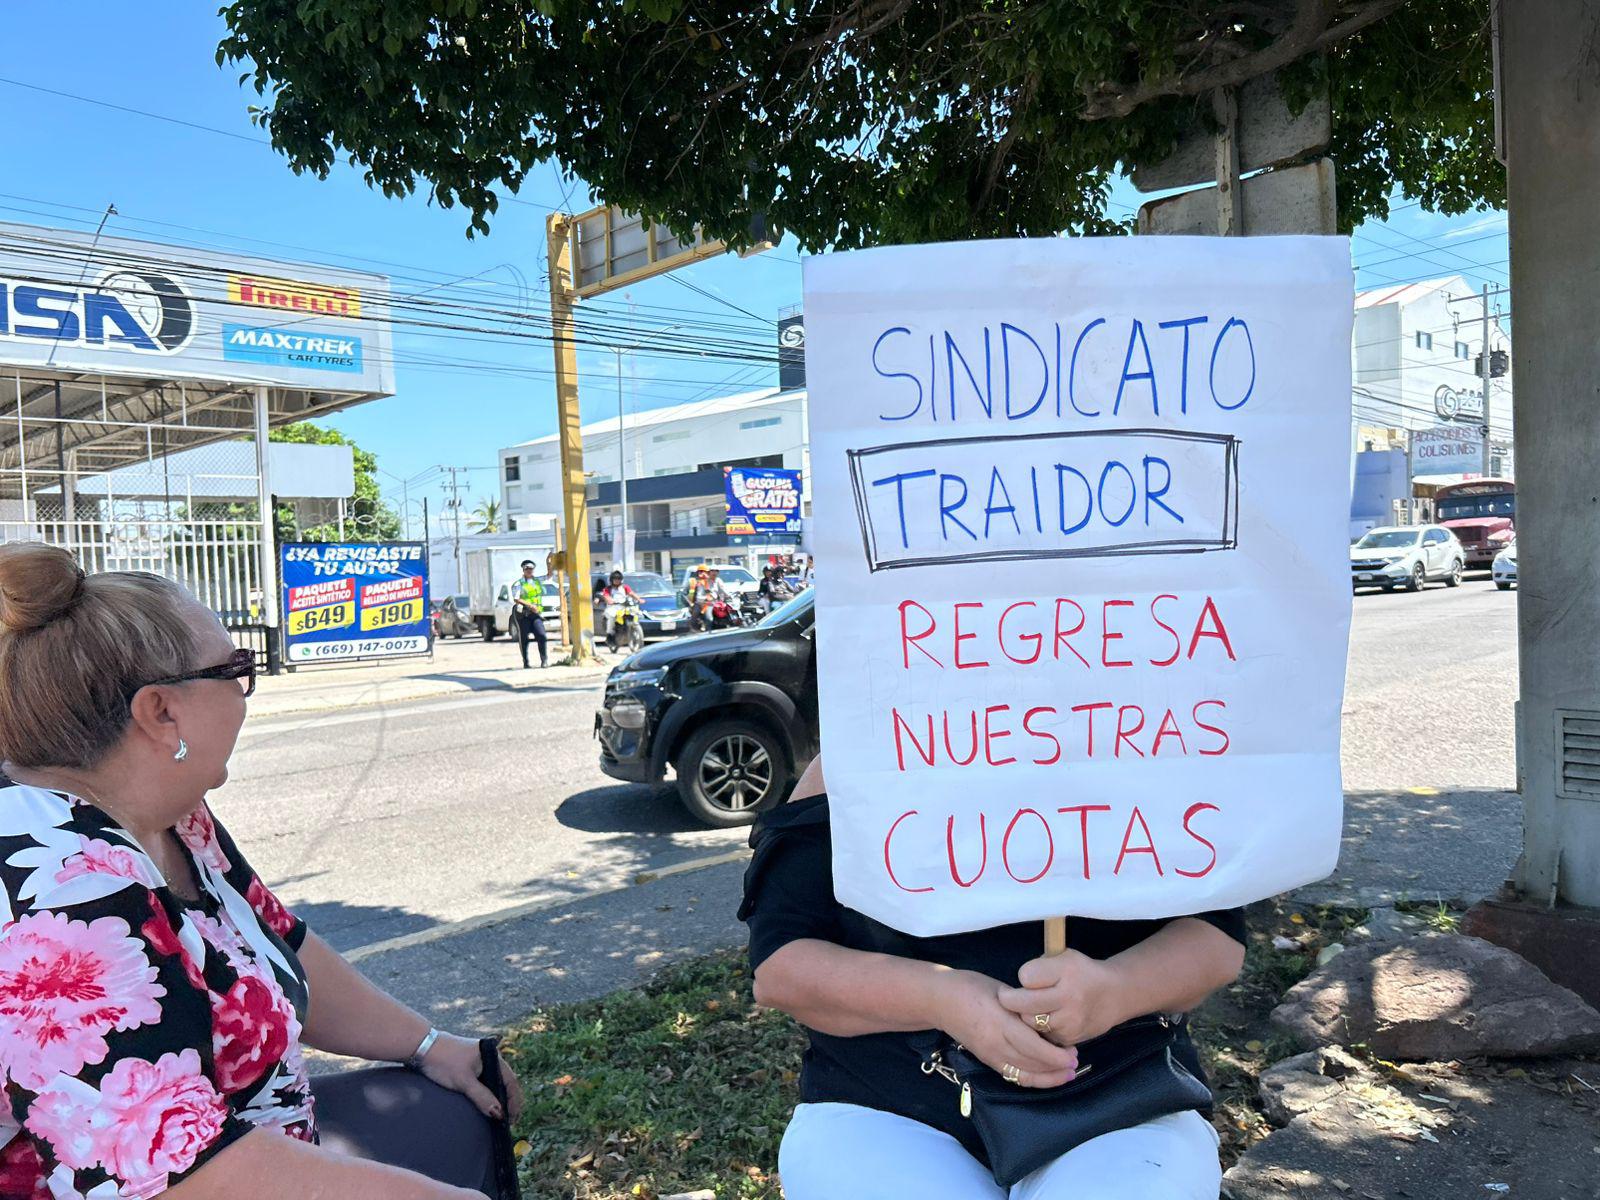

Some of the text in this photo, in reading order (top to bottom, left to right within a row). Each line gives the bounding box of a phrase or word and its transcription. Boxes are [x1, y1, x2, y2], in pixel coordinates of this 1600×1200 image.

[238, 277, 349, 315] PIRELLI
[230, 330, 355, 356] MAXTREK
[287, 353, 354, 367] CAR TYRES
[872, 316, 1256, 421] SINDICATO
[1419, 443, 1476, 458] COLISIONES
[739, 489, 799, 509] GRATIS
[872, 455, 1184, 548] TRAIDOR
[286, 546, 422, 562] ¿YA REVISASTE
[313, 561, 400, 576] TU AUTO?
[295, 579, 347, 598] PAQUETE
[365, 577, 413, 596] PAQUETE
[292, 595, 316, 609] ACEITE
[296, 605, 345, 631] $649
[371, 603, 413, 626] $190
[898, 594, 1237, 669] REGRESA
[316, 640, 418, 656] (669) 147-0073
[892, 700, 1230, 771] NUESTRAS
[884, 802, 1221, 893] CUOTAS
